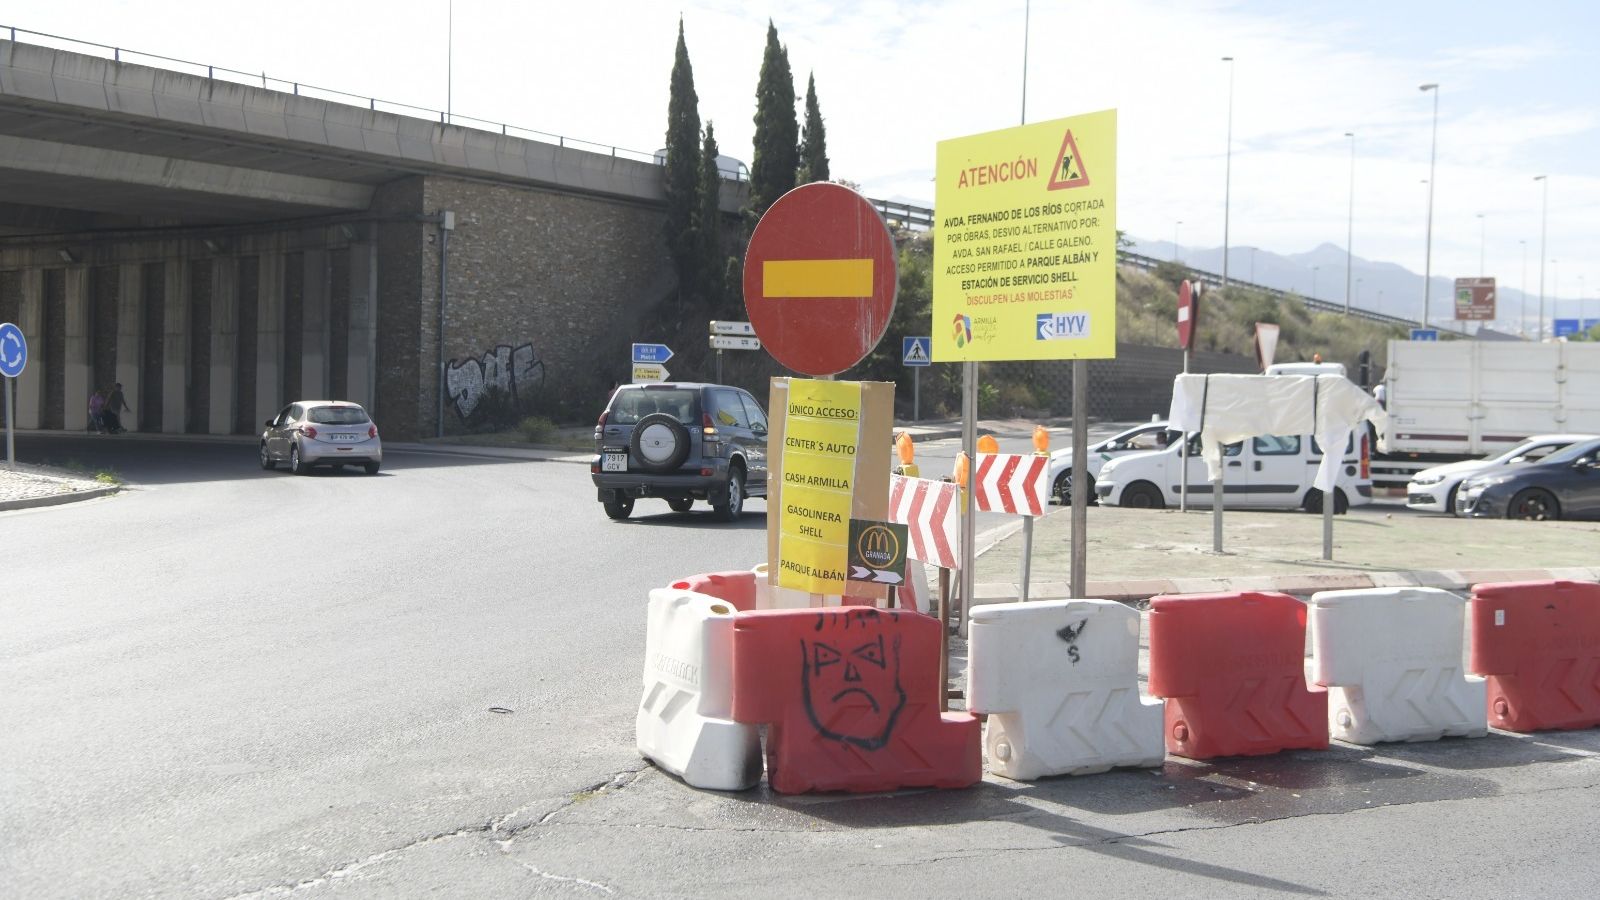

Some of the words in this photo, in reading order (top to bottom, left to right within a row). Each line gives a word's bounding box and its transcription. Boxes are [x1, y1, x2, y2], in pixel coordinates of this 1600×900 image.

[958, 155, 1037, 189] ATENCIÓN
[944, 216, 966, 228] AVDA.
[968, 209, 1009, 225] FERNANDO
[1011, 208, 1022, 219] DE
[1024, 206, 1040, 218] LOS
[1042, 202, 1062, 216] RÍOS
[1064, 199, 1104, 213] CORTADA
[947, 232, 962, 243] POR
[993, 227, 1021, 239] DESVIO
[1022, 220, 1077, 235] ALTERNATIVO
[1080, 217, 1100, 229] POR:
[952, 248, 974, 259] AVDA.
[975, 246, 991, 256] SAN
[993, 243, 1023, 255] RAFAEL
[1029, 239, 1054, 251] CALLE
[1057, 235, 1093, 249] GALENO.
[946, 263, 976, 276] ACCESO
[977, 259, 1018, 273] PERMITIDO
[1019, 258, 1026, 268] A
[1027, 255, 1061, 268] PARQUE
[1062, 252, 1091, 265] ALBÁN
[1092, 251, 1099, 262] Y
[962, 276, 998, 290] ESTACIÓN
[1000, 276, 1011, 287] DE
[1012, 273, 1049, 286] SERVICIO
[1010, 293, 1025, 303] LAS
[1056, 315, 1086, 333] HYV
[789, 402, 814, 416] ÚNICO
[816, 407, 859, 419] ACCESO:
[826, 443, 856, 455] AUTO
[607, 454, 625, 462] 7917
[785, 472, 806, 484] CASH
[807, 475, 849, 489] ARMILLA
[787, 504, 842, 523] GASOLINERA
[799, 525, 823, 538] SHELL
[865, 550, 891, 561] GRANADA
[780, 559, 811, 577] PARQUE
[812, 568, 845, 582] ALBÁN
